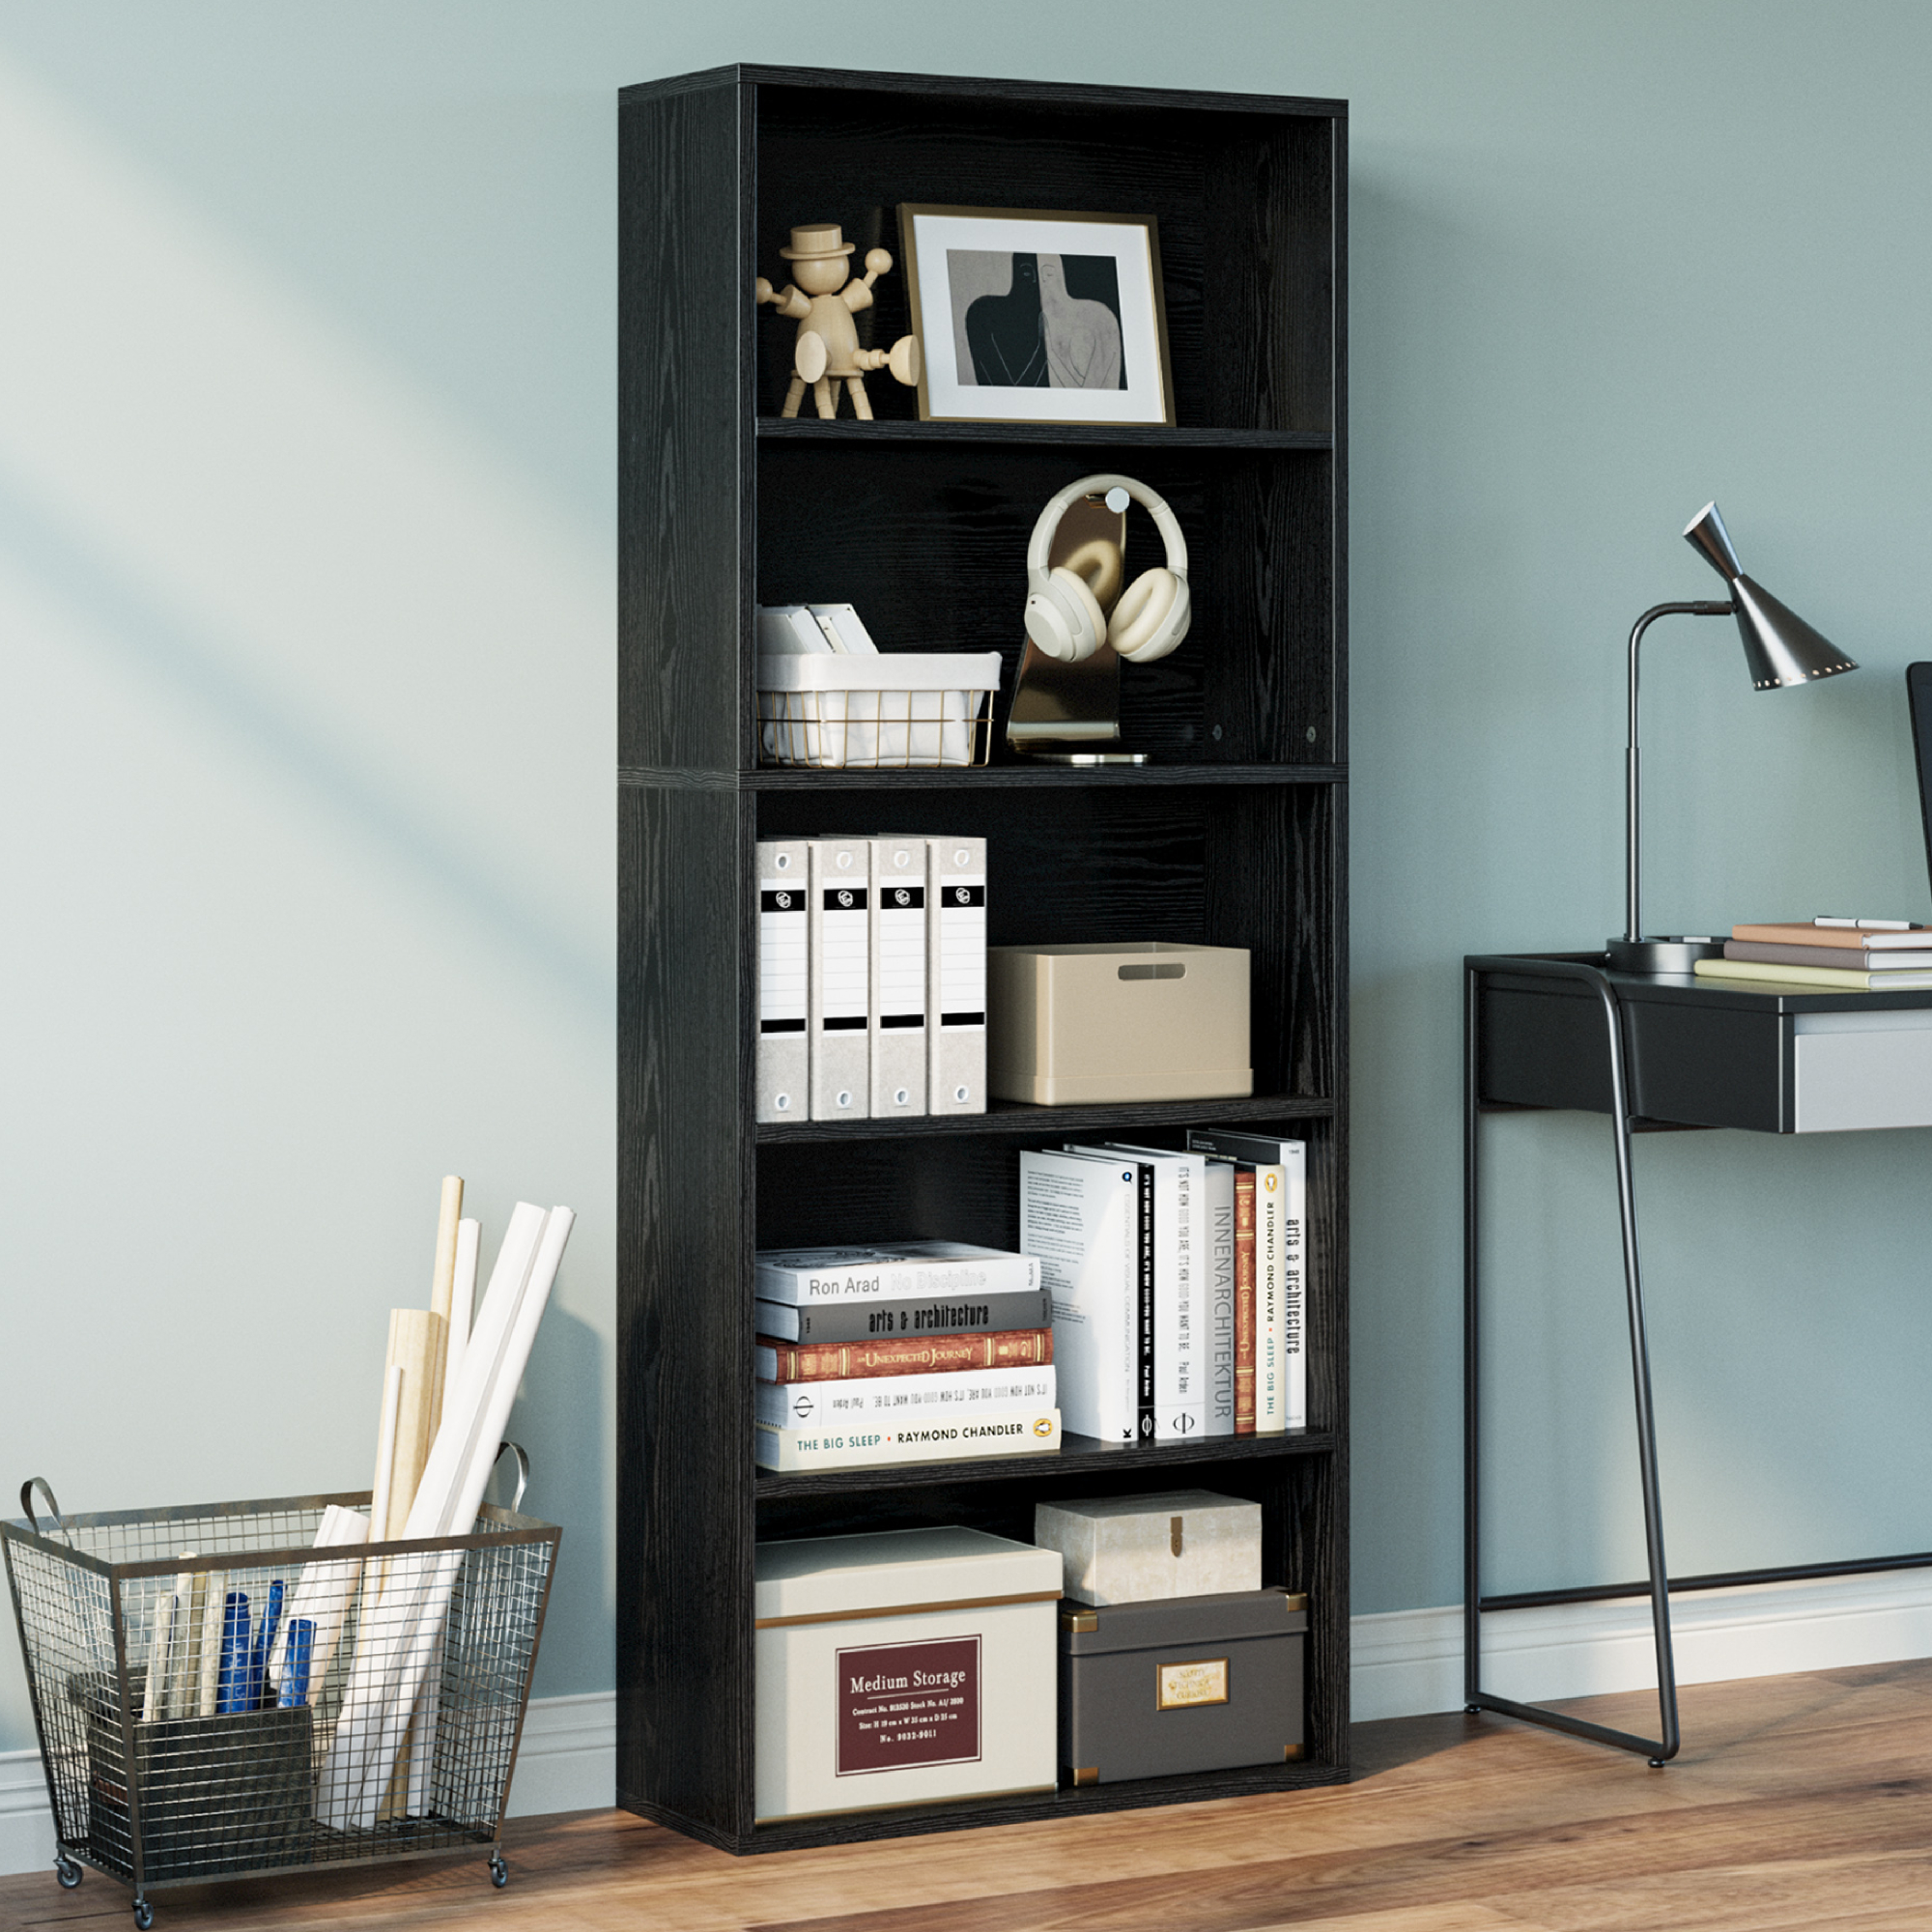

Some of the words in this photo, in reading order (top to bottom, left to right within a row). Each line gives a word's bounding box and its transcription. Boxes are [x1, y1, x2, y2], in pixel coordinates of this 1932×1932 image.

[1178, 1179, 1189, 1191] NOT
[1287, 1219, 1301, 1246] arts
[810, 1279, 839, 1295] Ron
[844, 1276, 880, 1293] Arad
[891, 1273, 912, 1291] No
[917, 1268, 987, 1292] Discipline
[869, 1309, 894, 1332] arts
[900, 1311, 908, 1330] &
[915, 1304, 989, 1329] architecture
[1214, 1206, 1232, 1418] INNENARCHITEKTUR
[1287, 1269, 1301, 1354] architecture
[1178, 1315, 1189, 1331] WANT
[866, 1350, 930, 1367] UNEXPECTED
[929, 1347, 973, 1367] JOURNEY
[1179, 1361, 1189, 1375] Paul
[940, 1390, 952, 1403] HOW
[1009, 1385, 1023, 1397] HOW
[1024, 1384, 1036, 1397] NOT
[893, 1394, 908, 1406] WANT
[897, 1430, 958, 1443] RAYMOND
[962, 1423, 1024, 1438] CHANDLER
[797, 1439, 818, 1451] THE
[823, 1437, 844, 1449] BIG
[849, 1435, 881, 1448] SLEEP
[850, 1675, 908, 1693] Medium
[913, 1670, 966, 1688] Storage
